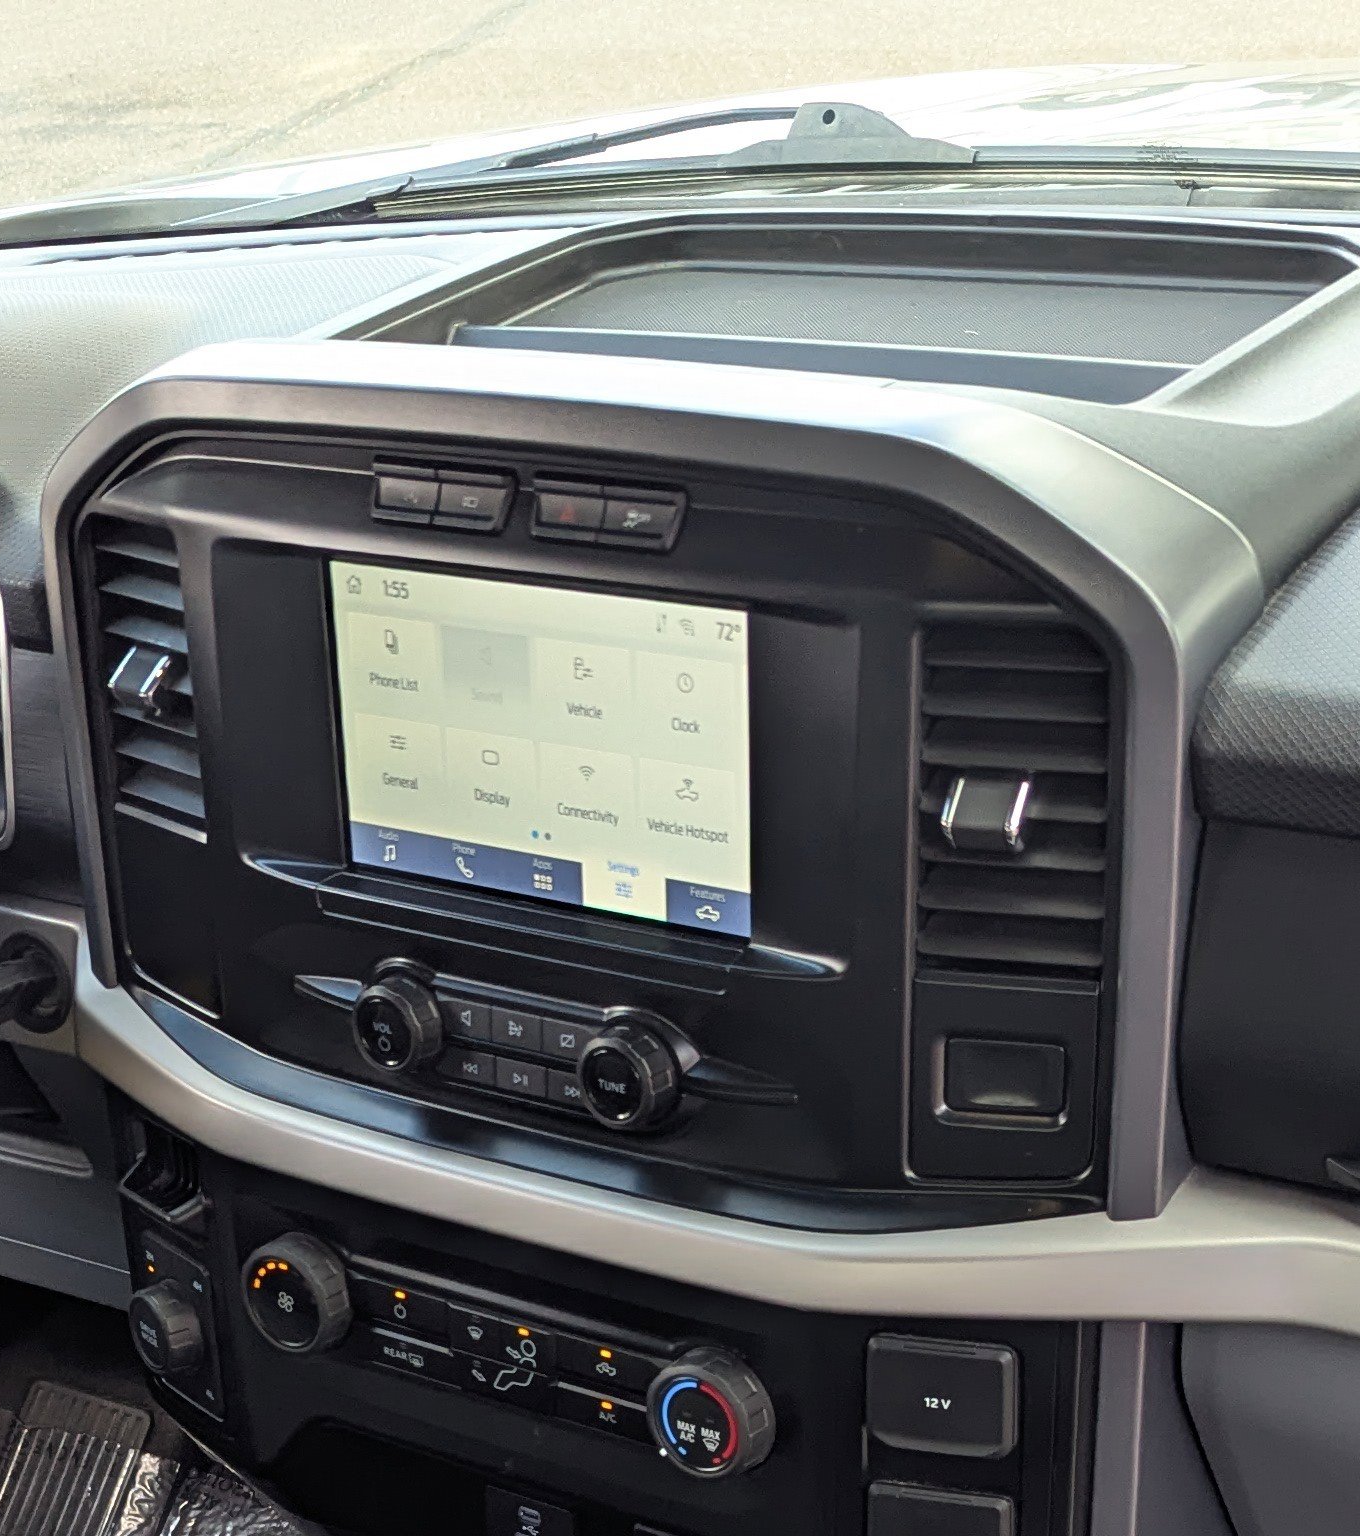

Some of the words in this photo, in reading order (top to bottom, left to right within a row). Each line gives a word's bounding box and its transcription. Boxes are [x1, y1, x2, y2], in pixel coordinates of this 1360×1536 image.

[381, 578, 410, 601] 1:55
[368, 670, 399, 690] Phone
[400, 676, 419, 693] List
[566, 701, 603, 721] Vehicle
[670, 716, 701, 735] Clock
[381, 772, 419, 792] General
[473, 787, 511, 809] Display
[556, 801, 620, 828] Connectivity
[377, 830, 400, 842] Audio
[646, 816, 684, 838] Vehicle
[685, 823, 730, 845] Hotspot
[451, 842, 477, 857] Phone
[532, 857, 553, 872] Apps
[606, 859, 640, 878] Settings
[689, 885, 726, 904] Features
[597, 1078, 627, 1096] TUNE
[382, 1345, 408, 1361] REAR
[676, 1419, 697, 1434] MAX
[701, 1426, 721, 1441] MAX
